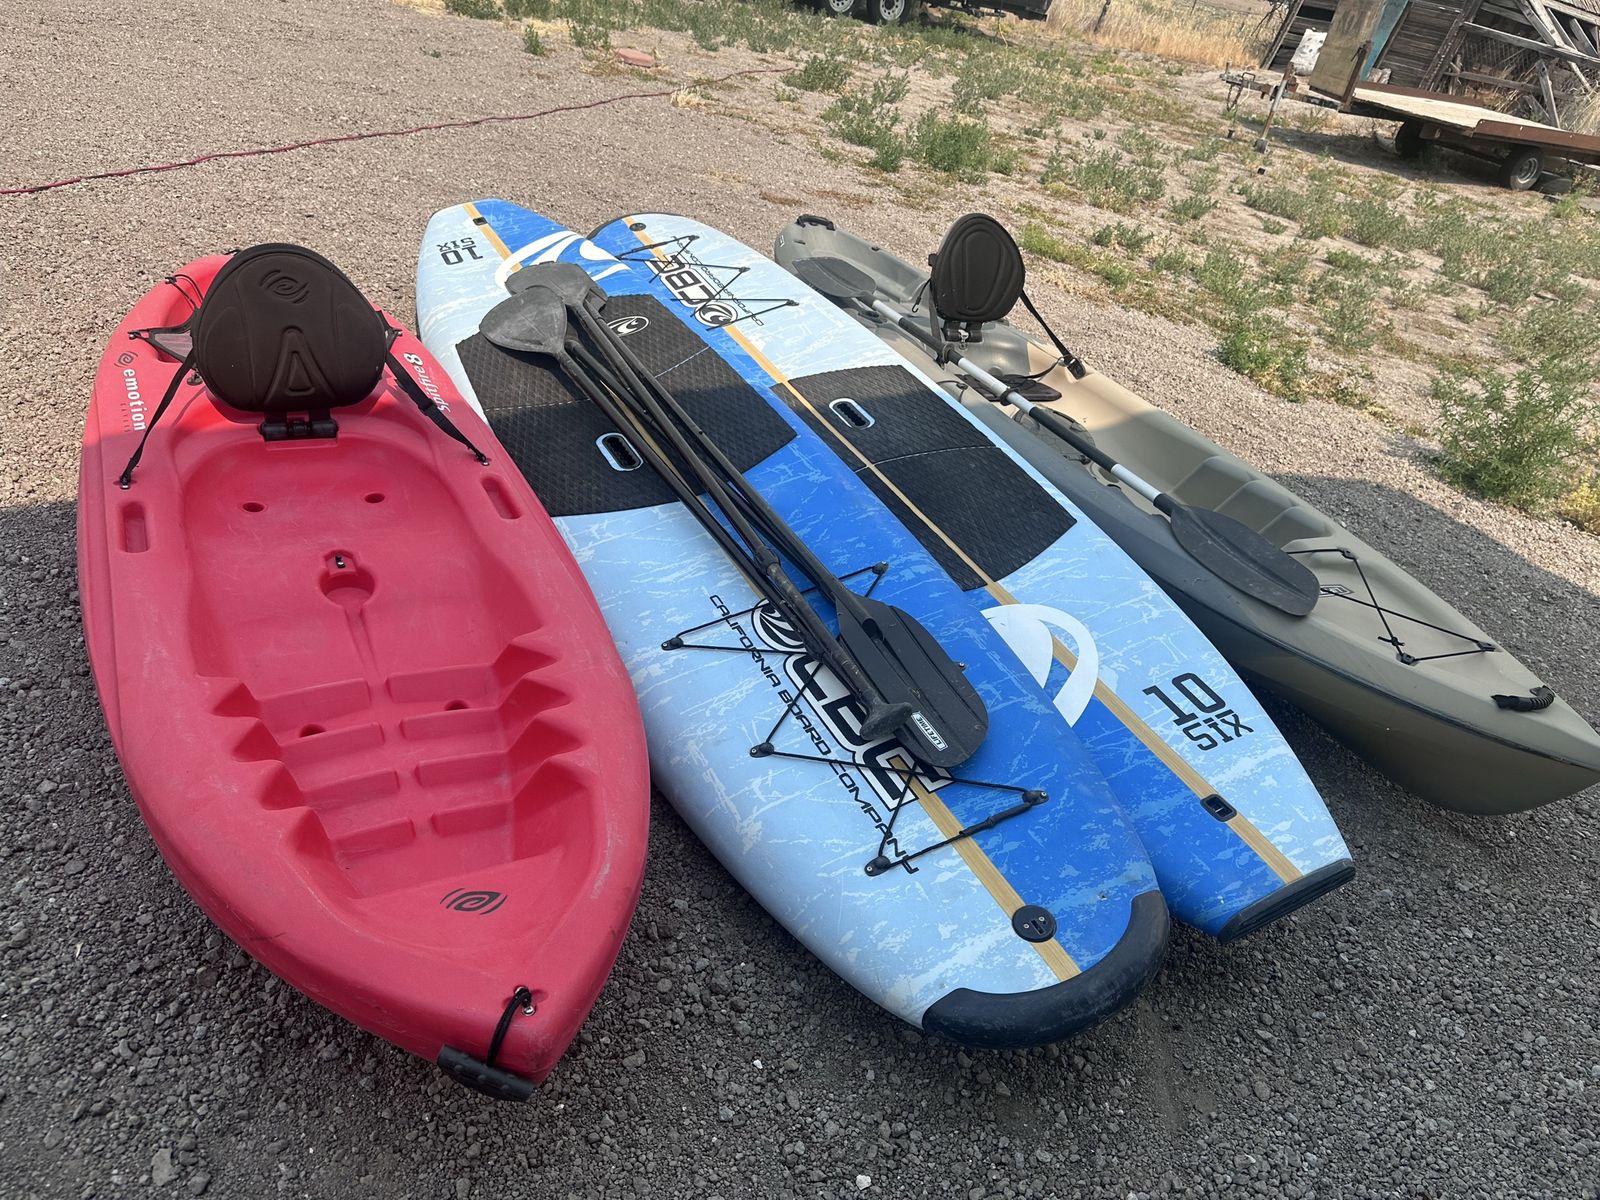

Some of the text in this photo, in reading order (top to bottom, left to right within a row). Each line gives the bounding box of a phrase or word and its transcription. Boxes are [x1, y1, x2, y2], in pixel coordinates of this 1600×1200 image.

[441, 245, 484, 266] 10
[123, 368, 146, 431] emotion
[1142, 672, 1227, 727] 10
[709, 594, 920, 875] CALIFORNIA BOARD COMPANY
[915, 716, 943, 746] LIFETIME
[1182, 708, 1255, 751] SIX
